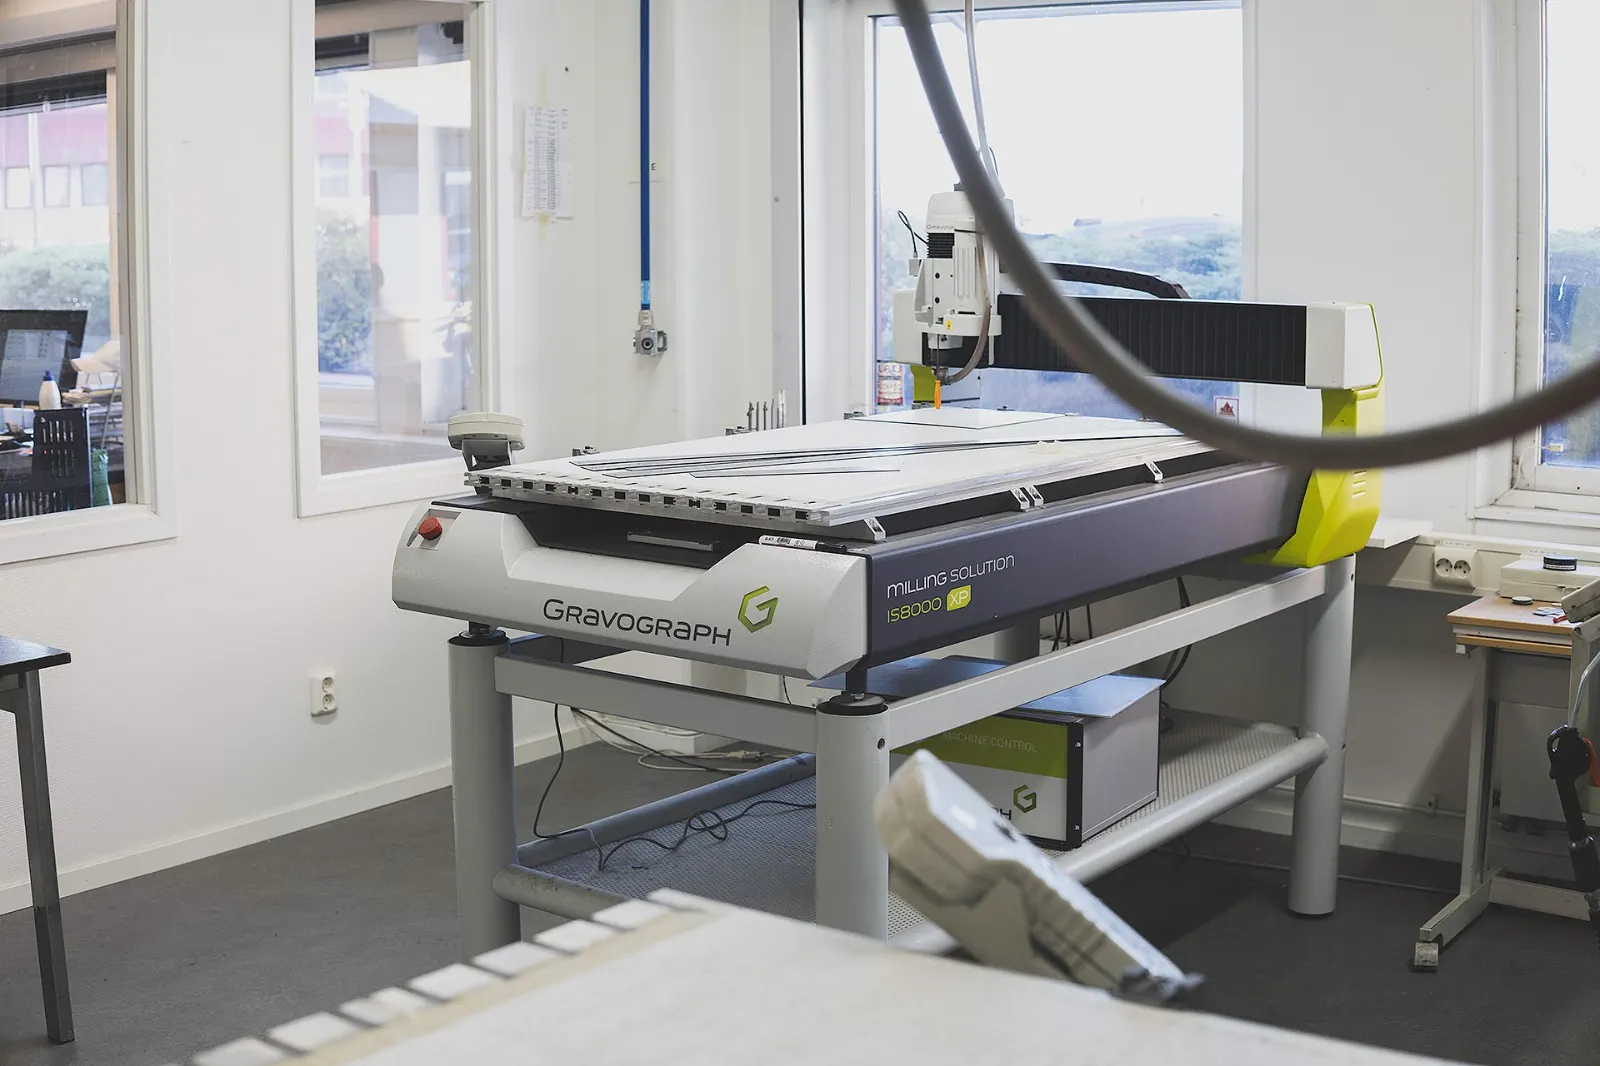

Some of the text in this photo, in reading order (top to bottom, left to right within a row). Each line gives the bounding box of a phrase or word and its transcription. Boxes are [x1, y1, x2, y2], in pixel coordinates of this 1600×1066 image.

[887, 555, 1015, 599] MILLING SOLUTION
[887, 590, 969, 623] IS8000 XP
[942, 731, 1038, 753] MACHINE CONTROL
